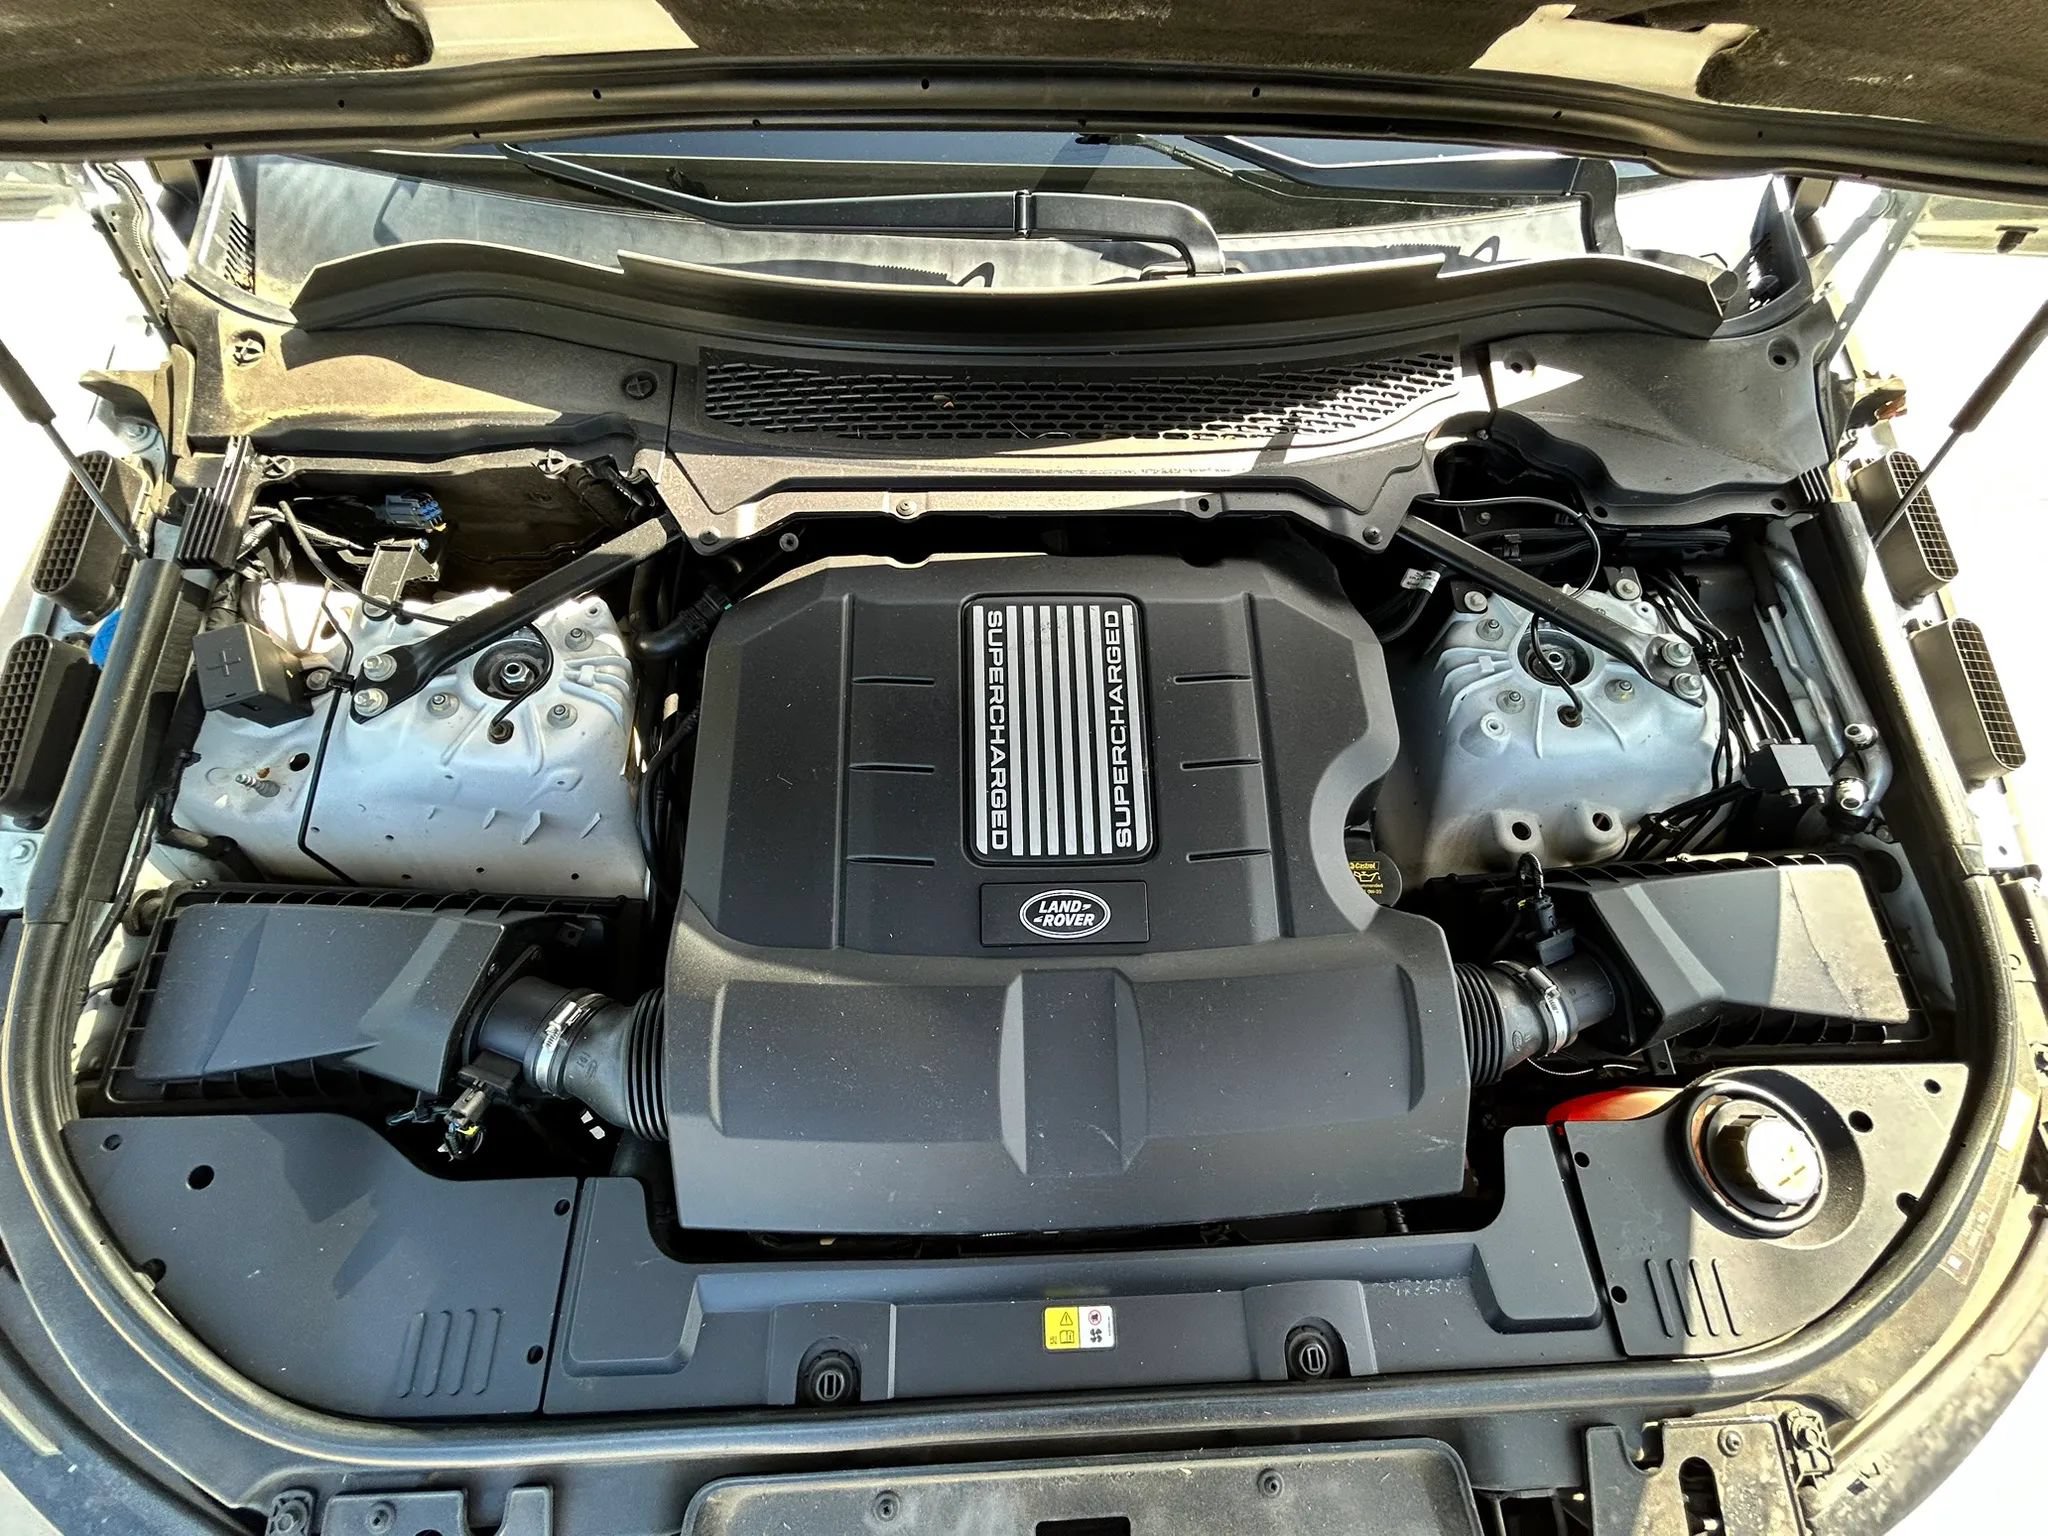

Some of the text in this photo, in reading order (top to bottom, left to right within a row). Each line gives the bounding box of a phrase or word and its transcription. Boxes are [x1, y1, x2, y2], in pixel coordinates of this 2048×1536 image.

[988, 610, 1007, 849] SUPERCHARGED
[1104, 610, 1132, 848] SUPERCHARGED
[1355, 862, 1376, 870] Castrol
[1039, 900, 1082, 914] LAND
[1042, 913, 1096, 927] ROVER
